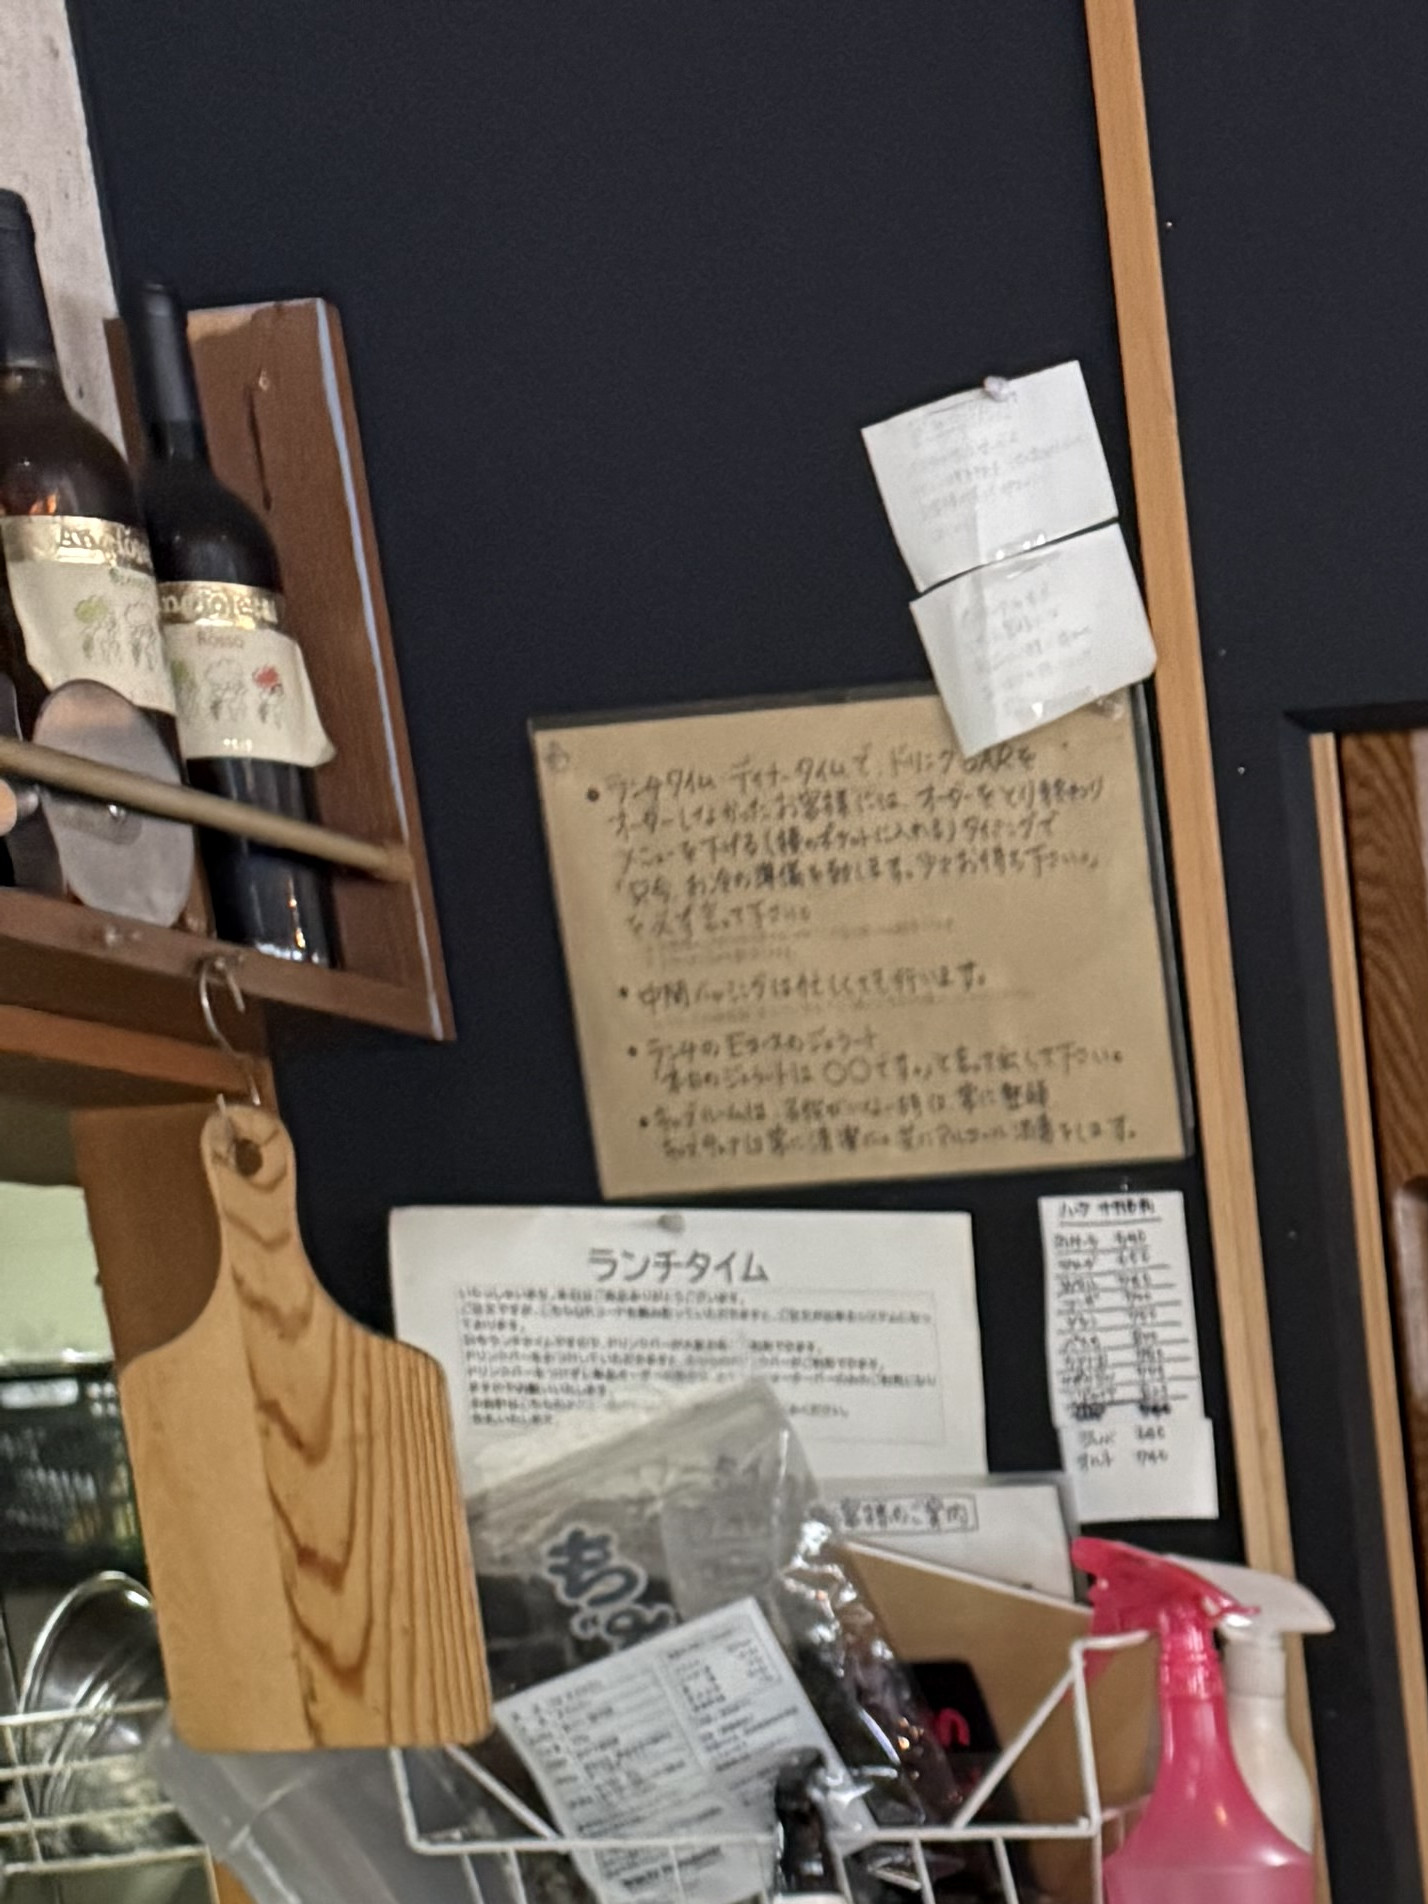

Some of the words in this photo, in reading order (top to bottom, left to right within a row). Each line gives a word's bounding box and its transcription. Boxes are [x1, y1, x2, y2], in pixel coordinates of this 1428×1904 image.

[587, 1247, 769, 1285] ランチタイム
